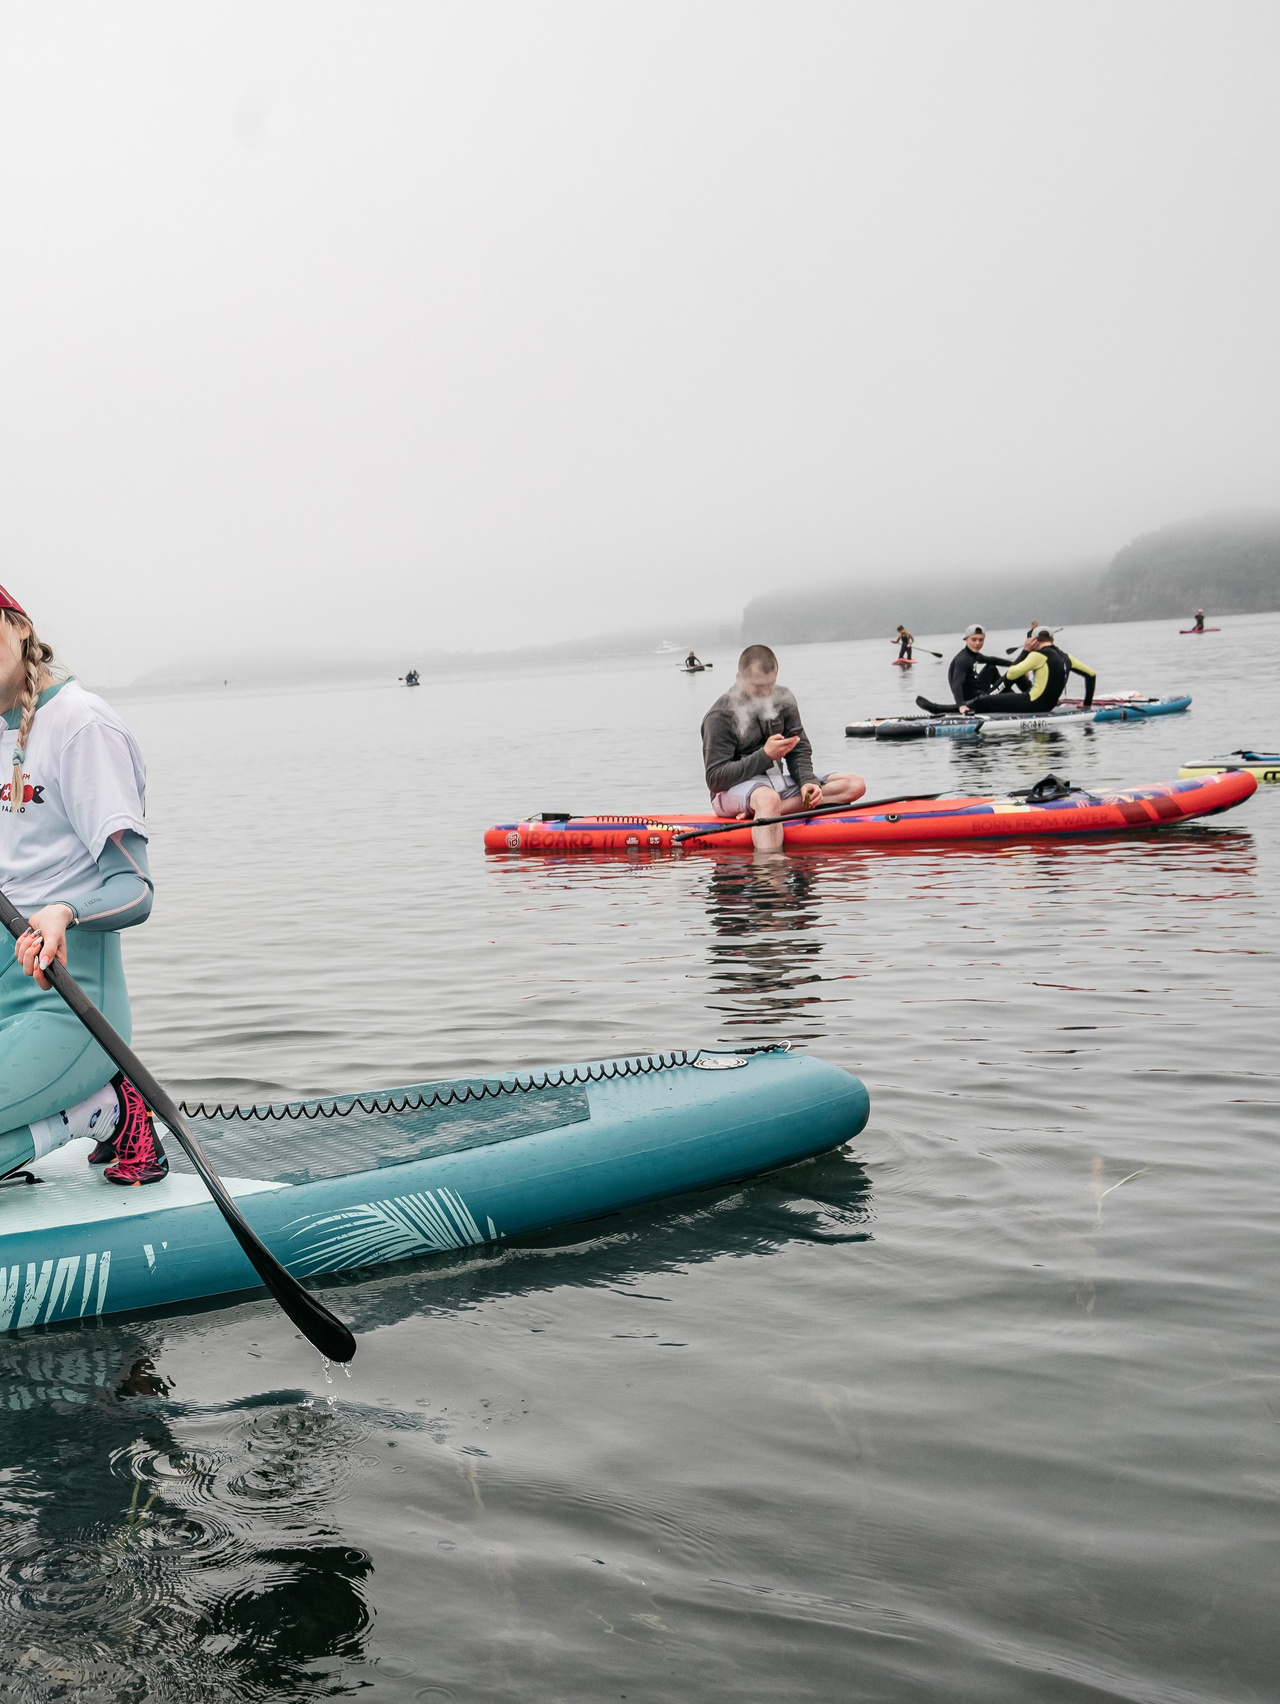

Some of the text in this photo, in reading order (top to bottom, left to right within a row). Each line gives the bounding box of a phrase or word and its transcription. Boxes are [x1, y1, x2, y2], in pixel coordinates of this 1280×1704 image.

[972, 812, 1109, 832] BORN FROM WATER
